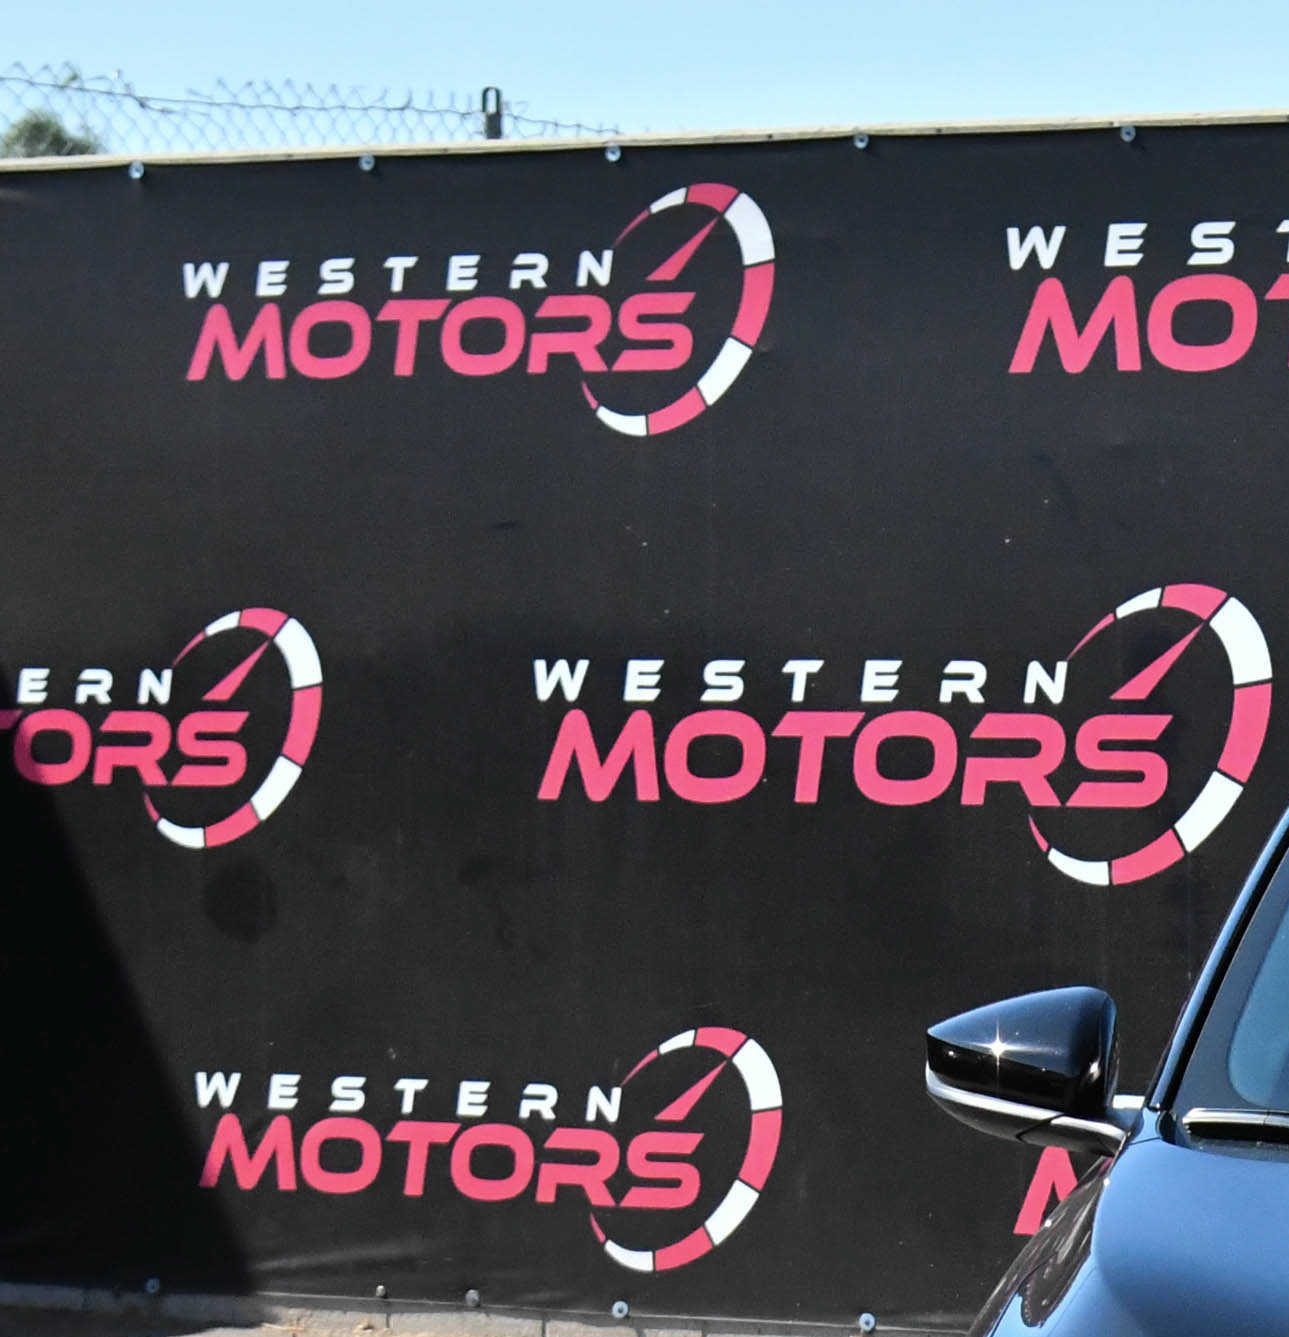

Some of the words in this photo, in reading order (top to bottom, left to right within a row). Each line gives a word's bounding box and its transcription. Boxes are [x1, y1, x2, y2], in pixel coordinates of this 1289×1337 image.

[184, 250, 613, 298] WESTERN
[187, 292, 694, 380] MOTORS
[534, 659, 1067, 704] WESTERN
[0, 708, 250, 787] ORS
[538, 709, 1172, 809] MOTORS
[195, 1072, 621, 1123] WESTERN
[201, 1113, 704, 1209] MOTORS
